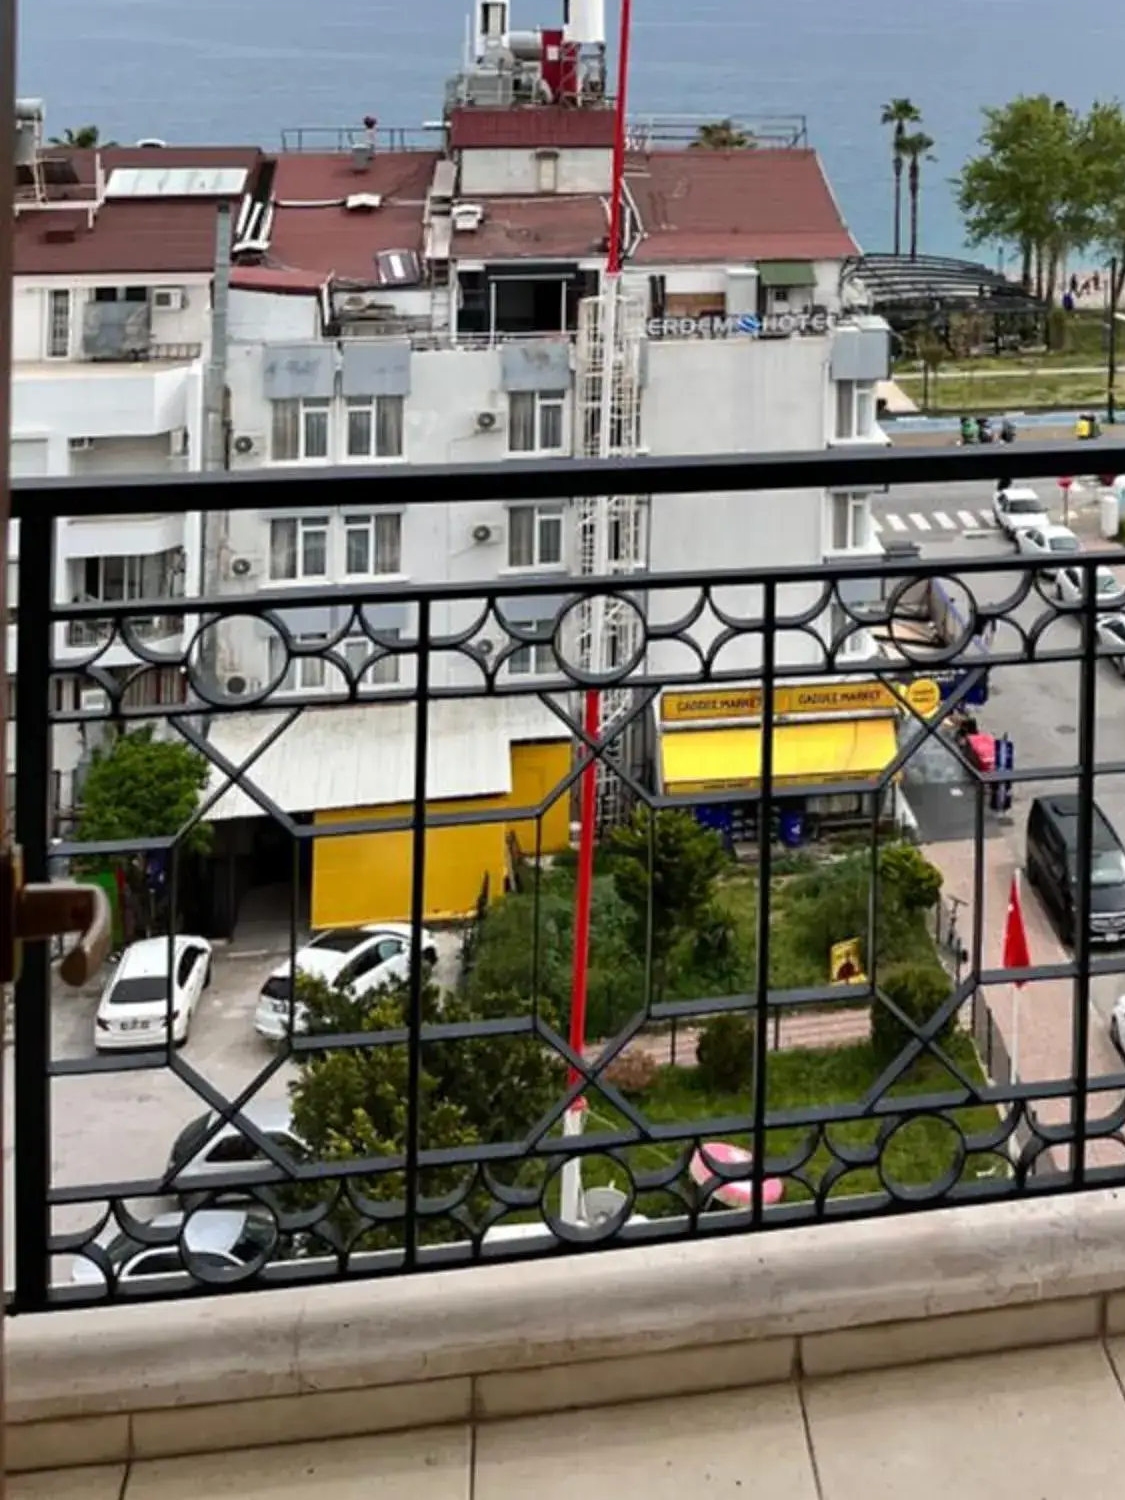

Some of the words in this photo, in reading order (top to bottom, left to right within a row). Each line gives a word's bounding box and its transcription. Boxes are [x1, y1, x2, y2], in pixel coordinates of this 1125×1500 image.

[649, 316, 734, 336] ERDEM
[762, 312, 837, 332] HOTEL
[841, 689, 881, 701] MARKET
